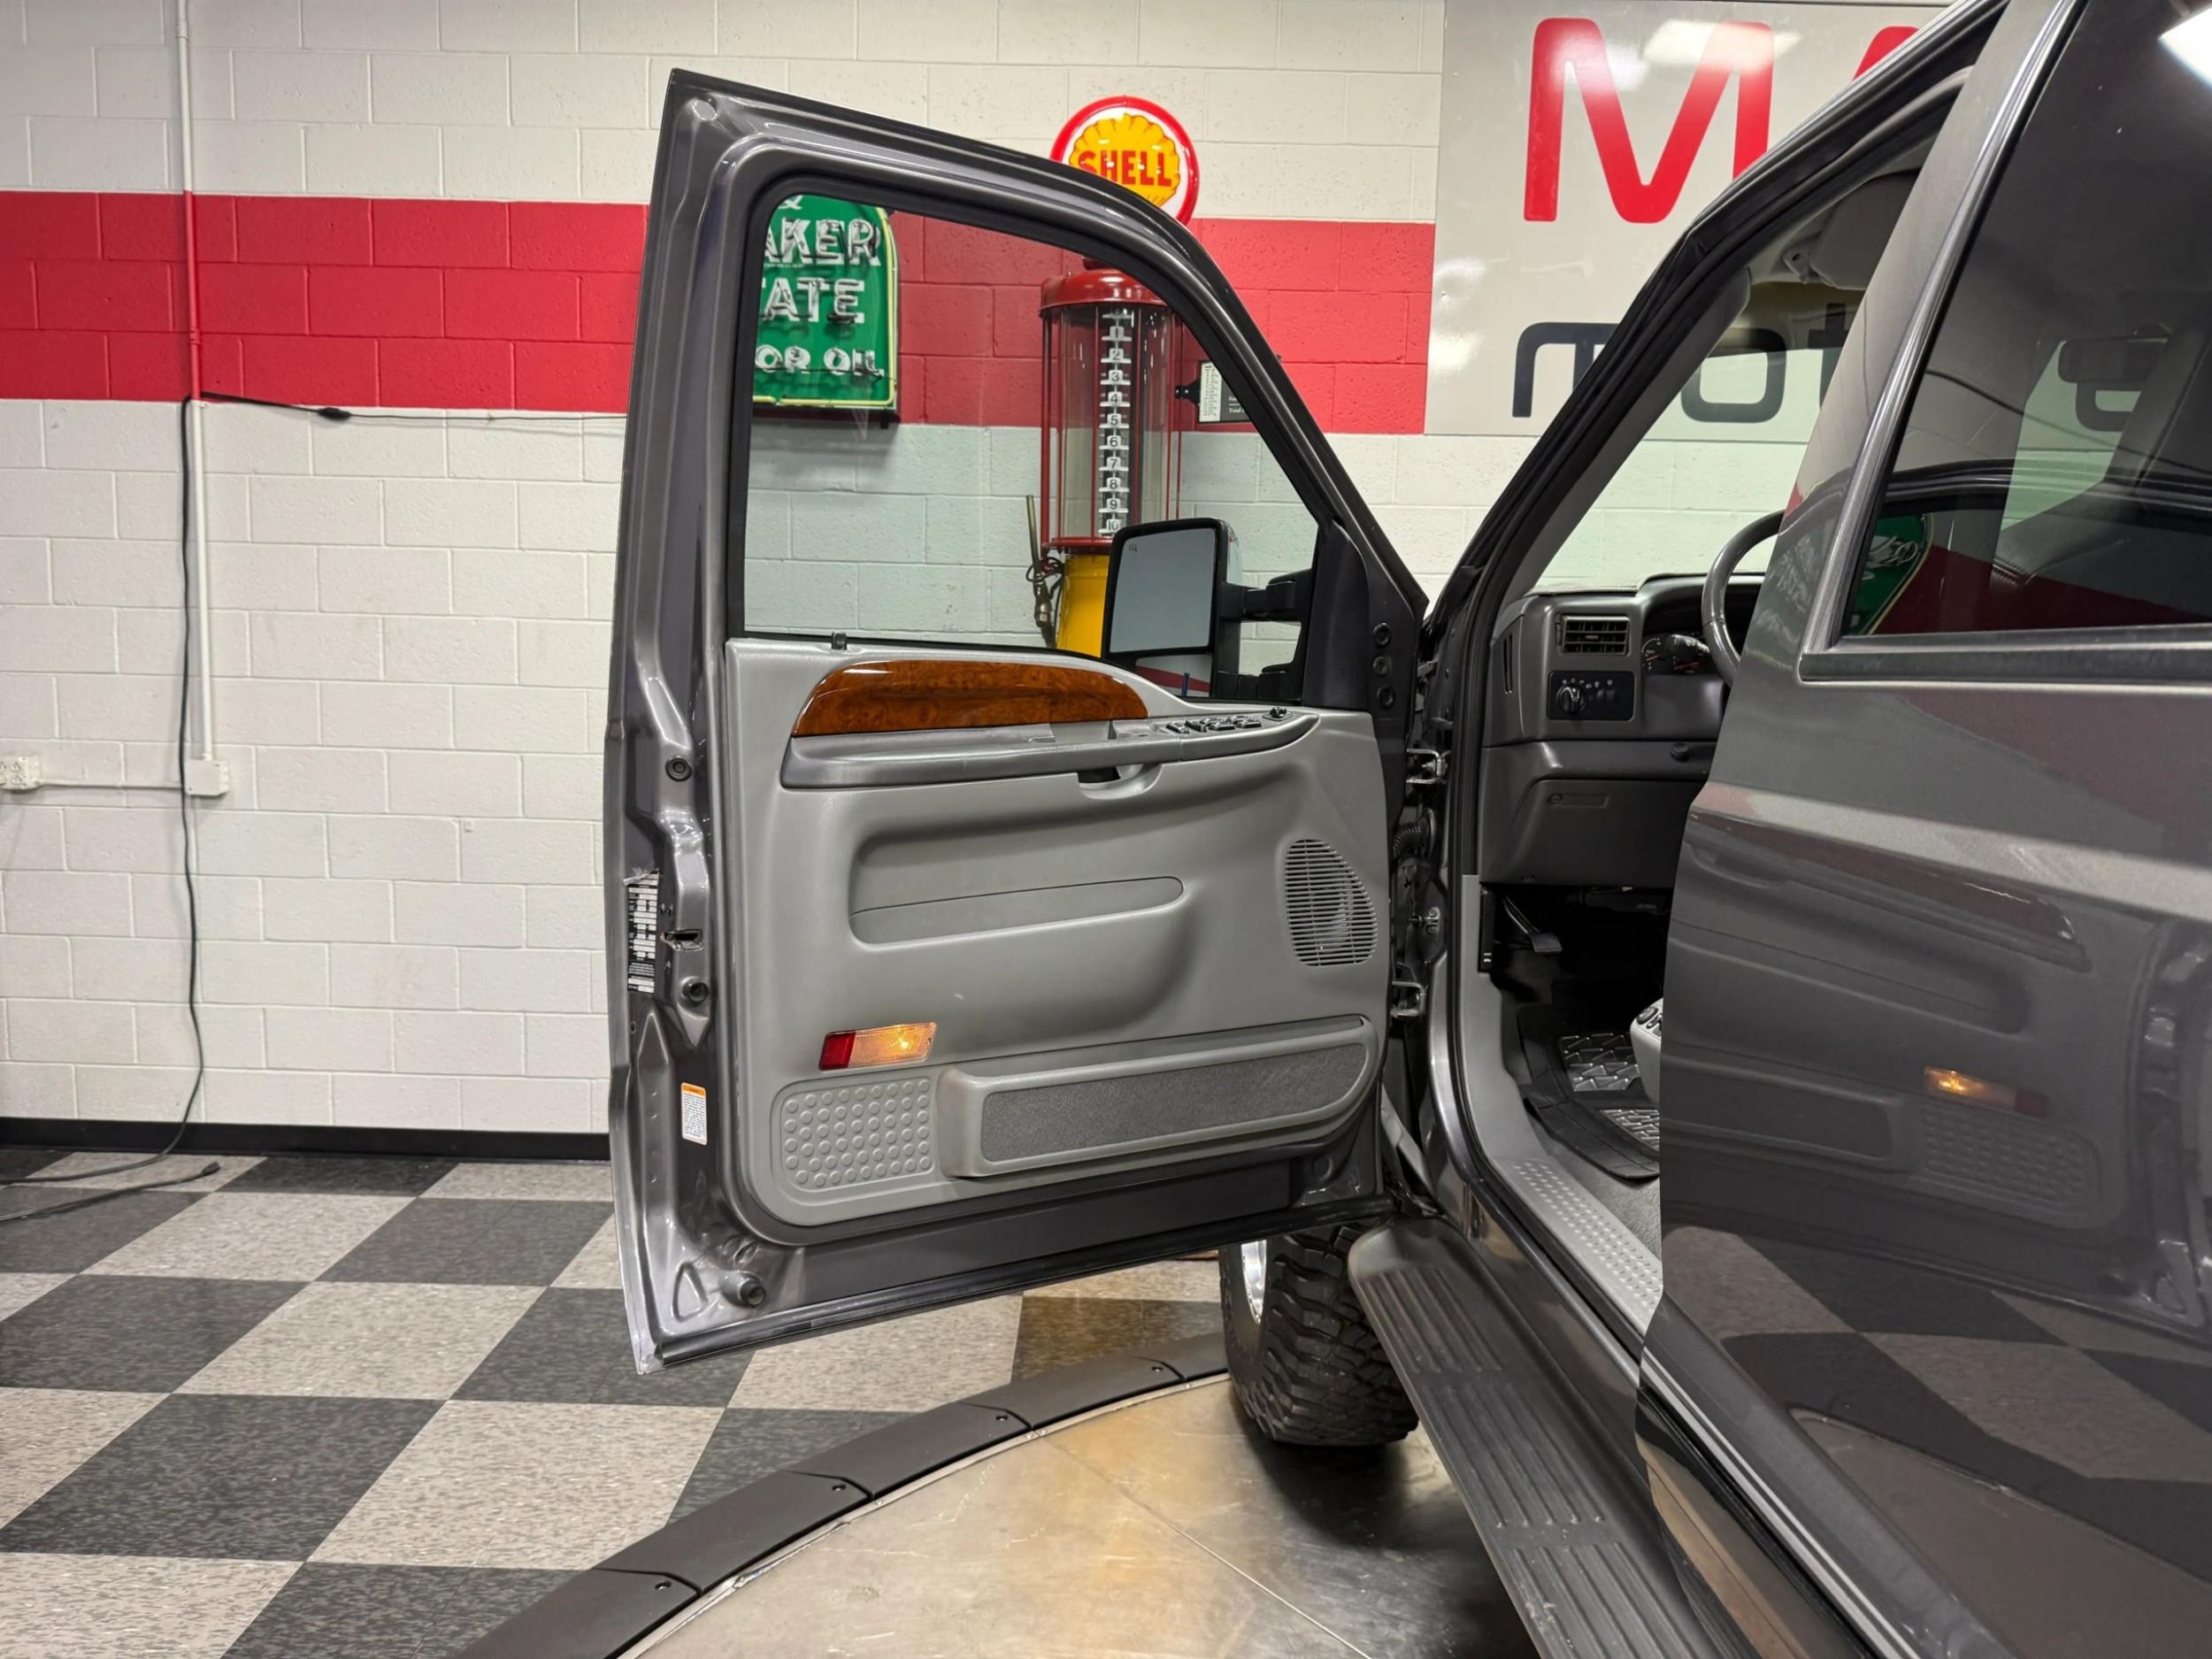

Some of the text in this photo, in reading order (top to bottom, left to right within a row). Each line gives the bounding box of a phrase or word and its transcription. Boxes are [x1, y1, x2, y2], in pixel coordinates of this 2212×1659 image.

[1078, 150, 1172, 188] SHELL
[762, 277, 864, 324] ATE
[823, 346, 885, 376] OIL
[1108, 520, 1119, 531] 10
